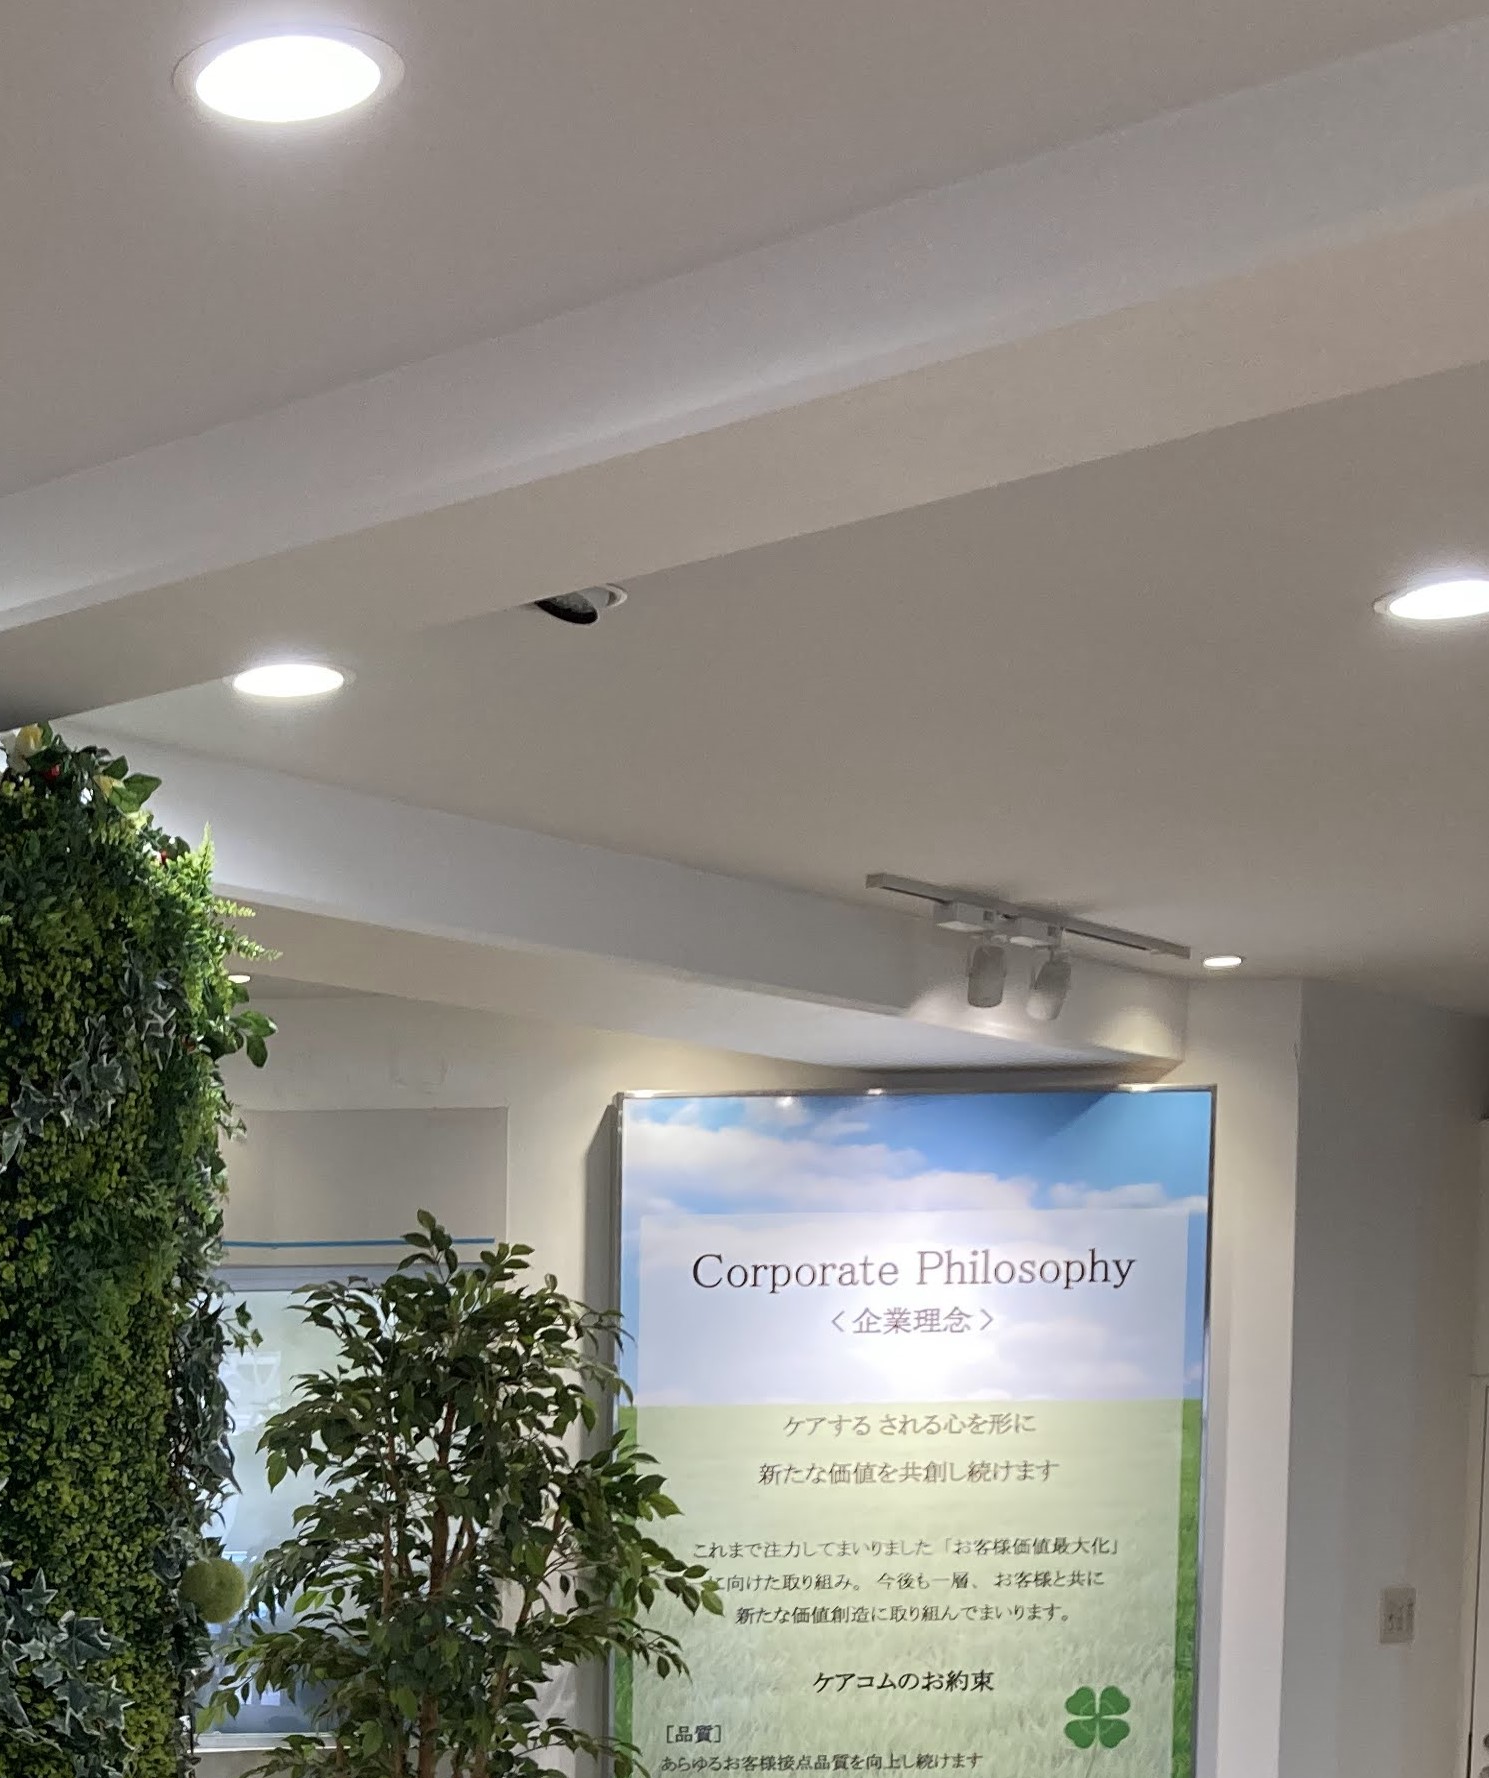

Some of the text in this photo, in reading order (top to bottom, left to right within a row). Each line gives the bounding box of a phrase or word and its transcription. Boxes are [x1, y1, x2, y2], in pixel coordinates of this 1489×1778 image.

[692, 1248, 1137, 1294] Corporate Philosophy
[758, 1460, 1059, 1486] 新たな価値を共創し続けます
[813, 1669, 995, 1693] ケアコムのお約束
[661, 1752, 983, 1772] あらゆるお客様接点品質を向上し続けます
